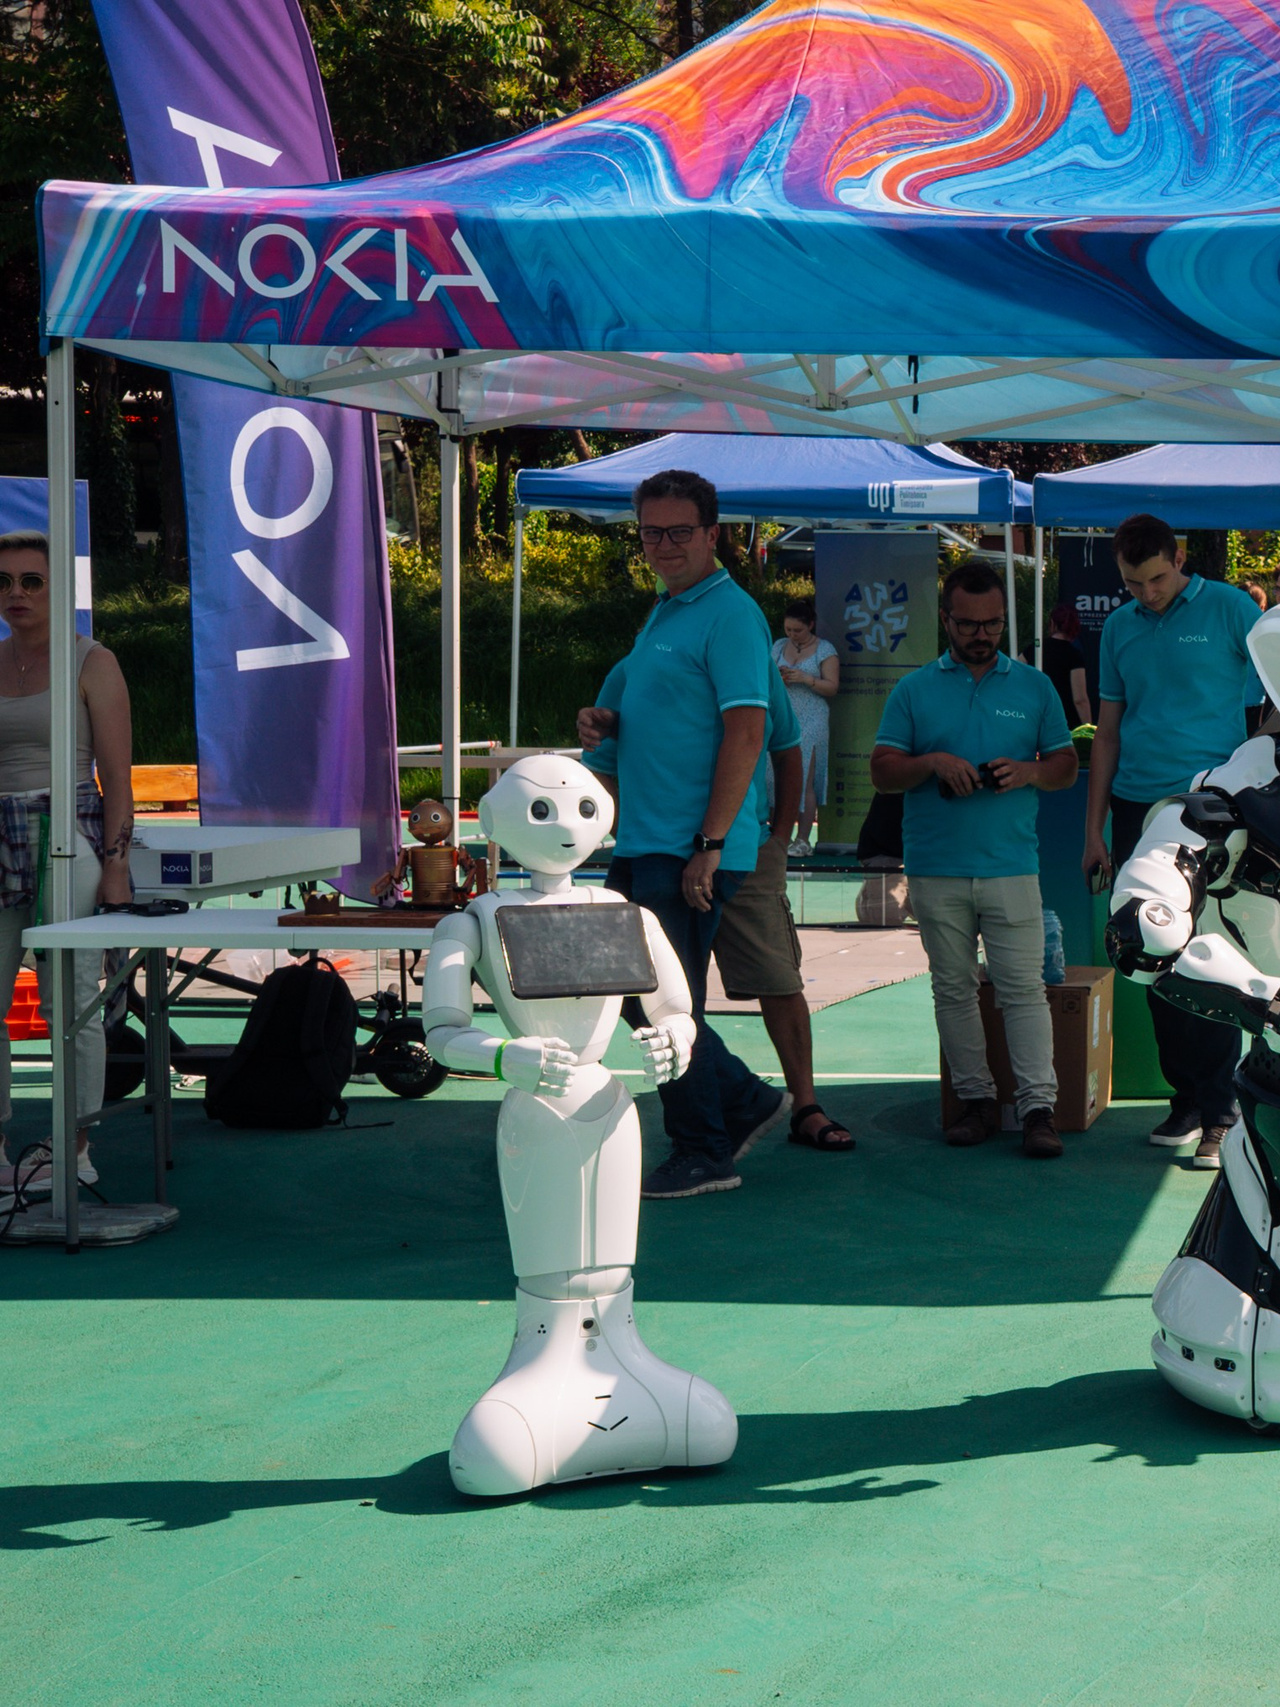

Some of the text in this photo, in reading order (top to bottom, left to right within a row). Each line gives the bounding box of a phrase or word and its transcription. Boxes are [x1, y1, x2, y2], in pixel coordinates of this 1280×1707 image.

[160, 217, 500, 303] NOKIA
[1179, 635, 1208, 643] NOKIA
[996, 709, 1025, 719] NOKIA
[163, 865, 189, 873] NOKIA
